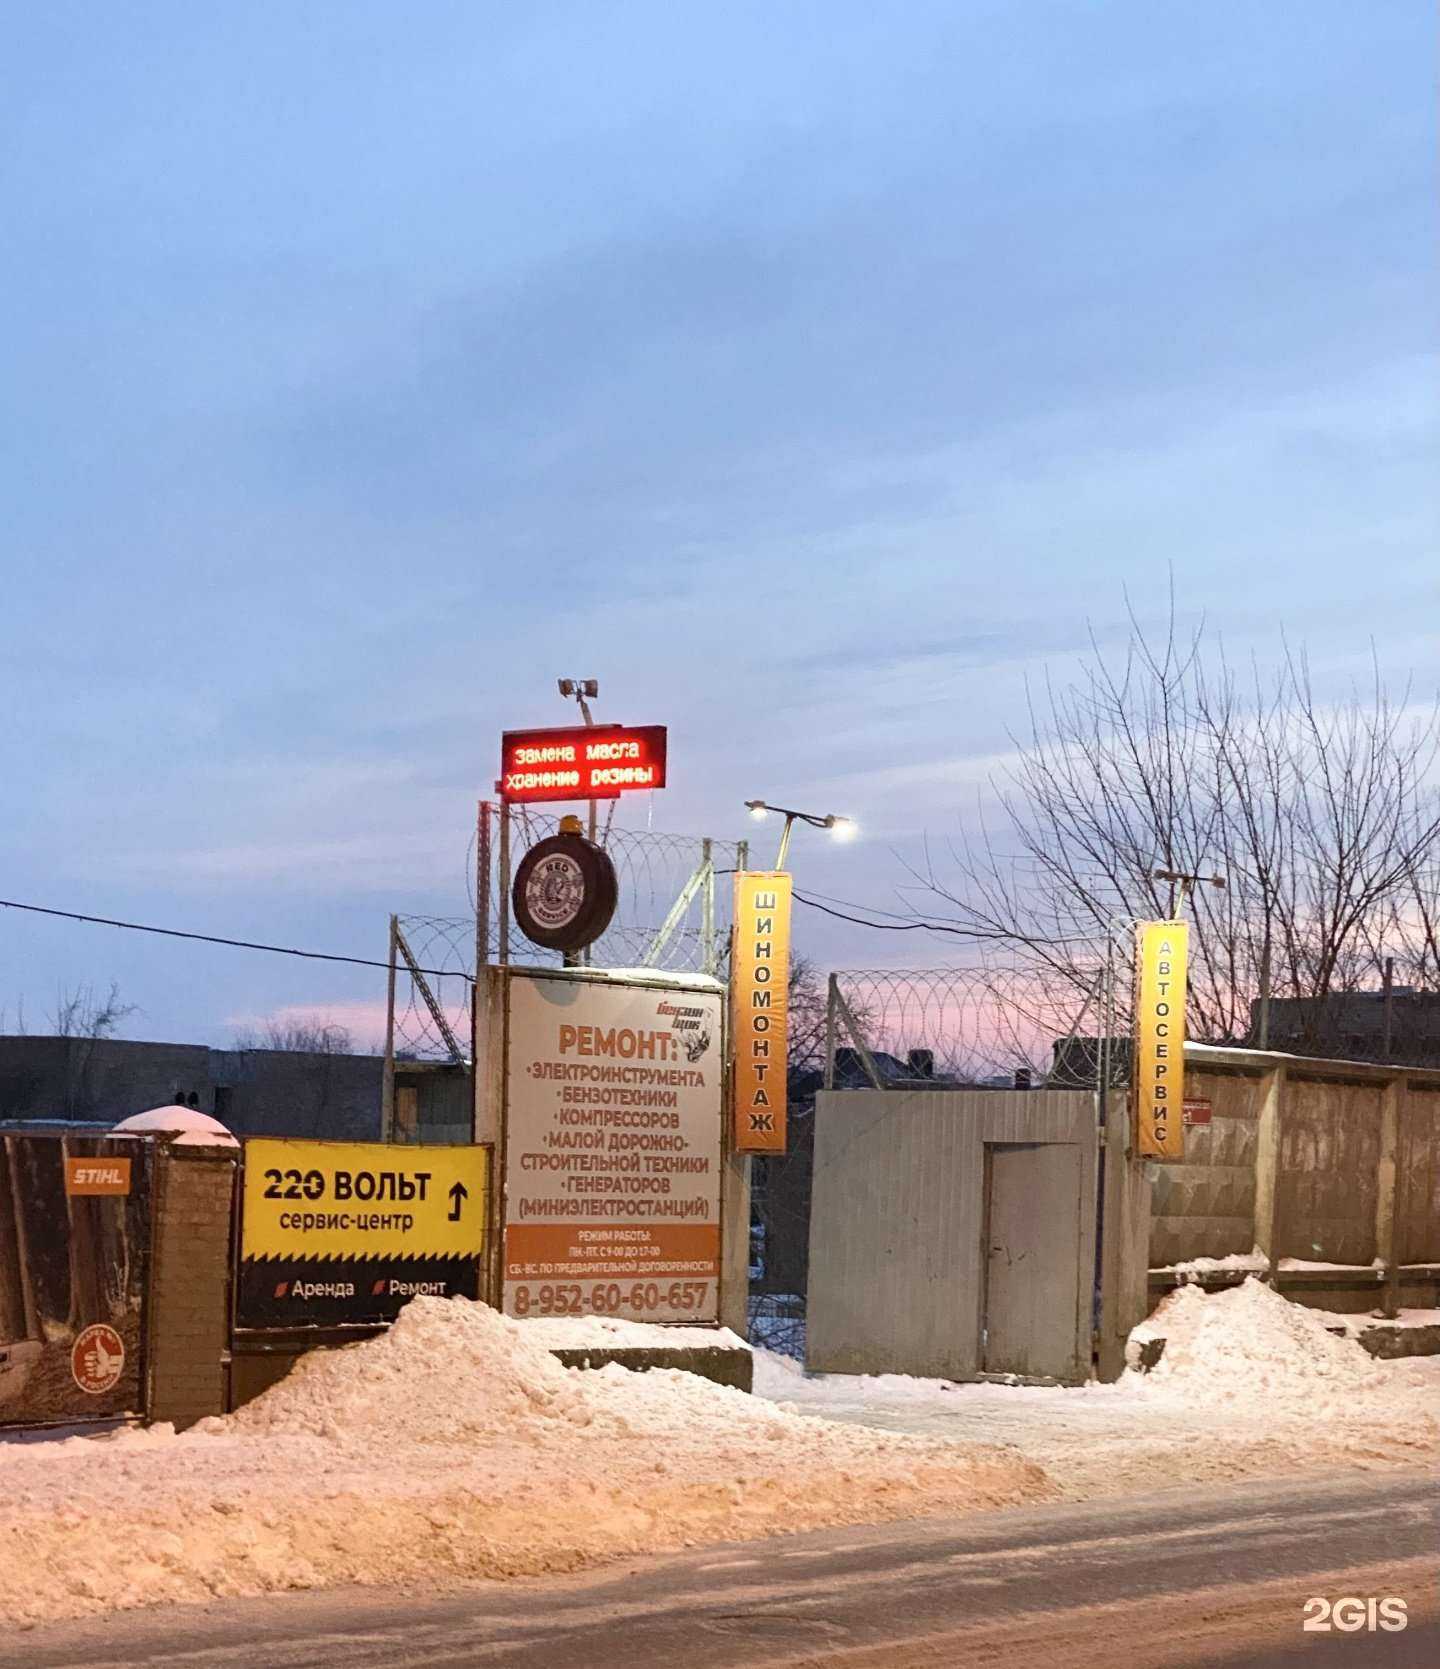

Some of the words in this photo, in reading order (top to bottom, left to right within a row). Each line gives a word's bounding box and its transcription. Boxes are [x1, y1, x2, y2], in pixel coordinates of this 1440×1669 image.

[506, 770, 580, 790] хранение
[590, 767, 654, 787] резины
[749, 892, 776, 1132] ШИНОМОНТАЖ
[559, 1024, 678, 1061] РЕМОНТ:
[1153, 941, 1170, 1142] АВТОСЕРВИС
[532, 1061, 705, 1087] ЭЛЕКТРОИНСТРУМЕНТА
[562, 1086, 677, 1107] БЕНЗОТЕХНИКИ
[559, 1108, 680, 1129] КОМПРЕССОРОВ
[549, 1130, 605, 1149] МАЛОЙ
[608, 1134, 689, 1151] ДОРОЖНО-
[520, 1152, 640, 1172] СТРОИТЕЛЬНОЙ
[643, 1156, 709, 1173] ТЕХНИКИ
[73, 1168, 124, 1184] STIHL
[264, 1169, 325, 1200] 220
[335, 1171, 431, 1201] ВОЛЬТ
[567, 1176, 671, 1194] ГЕНЕРАТОРОВ
[519, 1197, 709, 1219] (МИНИЭЛЕКТРОСТАНЦИЙ)
[279, 1213, 413, 1233] сервис-центр
[577, 1230, 613, 1242] РЕЖИМ
[624, 1247, 638, 1258] ДО
[539, 1263, 554, 1274] ПО
[555, 1260, 637, 1274] ПРЕДВАРИТЕЛЬНОЙ
[291, 1280, 355, 1299] Аренда
[389, 1280, 447, 1296] Ремонт
[514, 1282, 709, 1315] 8-952-60-60-657
